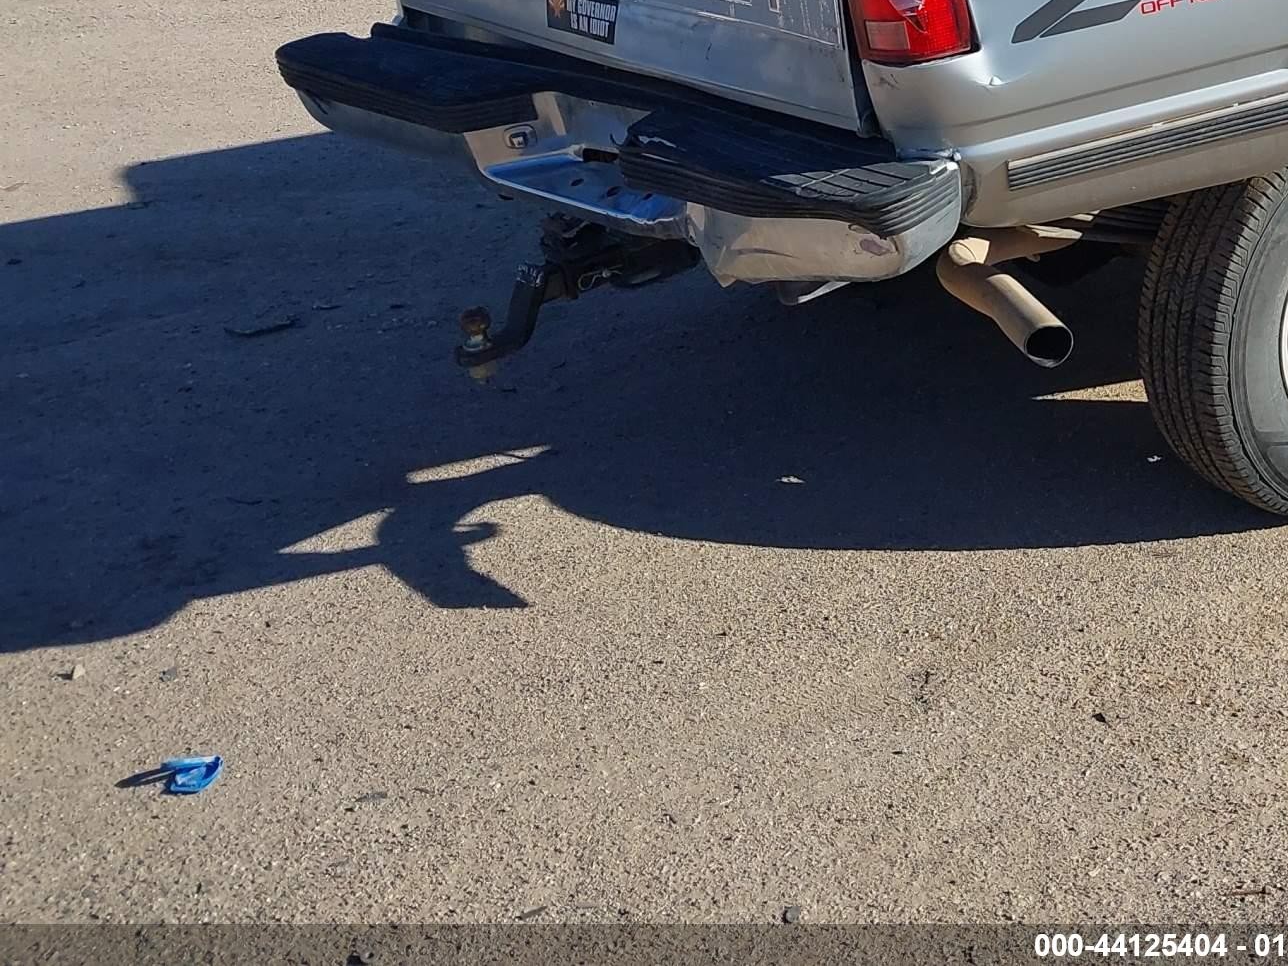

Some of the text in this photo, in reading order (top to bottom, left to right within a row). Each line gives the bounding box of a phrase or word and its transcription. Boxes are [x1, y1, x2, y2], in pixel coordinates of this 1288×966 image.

[570, 11, 610, 38] IS AN IDIOT
